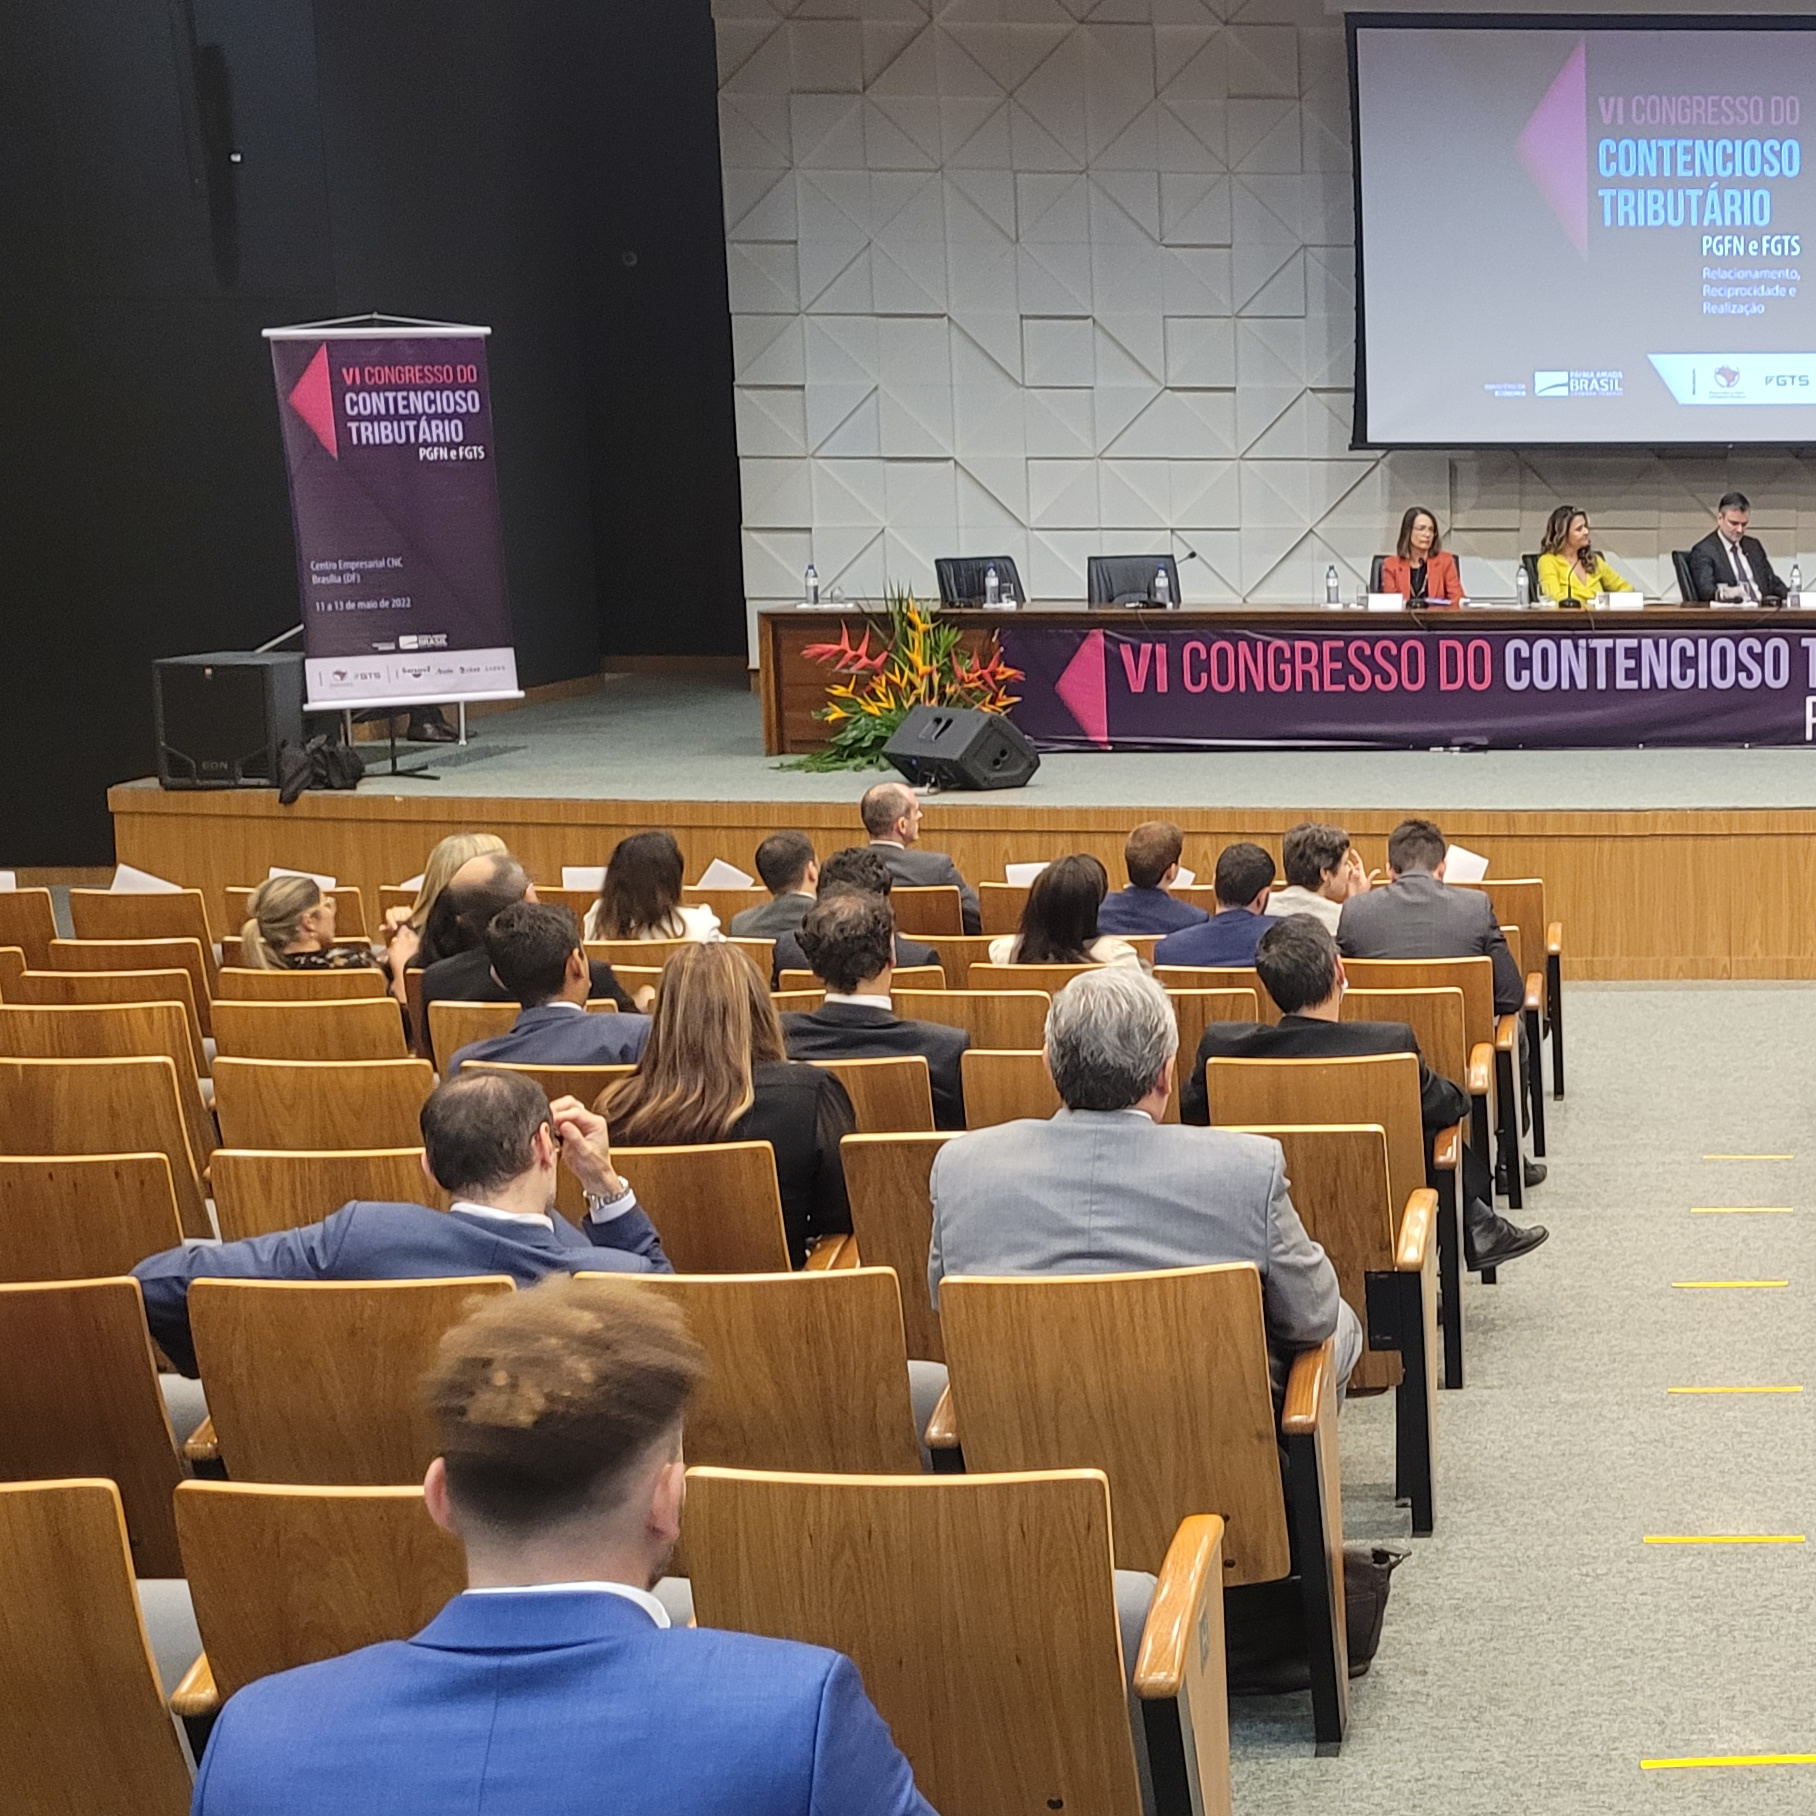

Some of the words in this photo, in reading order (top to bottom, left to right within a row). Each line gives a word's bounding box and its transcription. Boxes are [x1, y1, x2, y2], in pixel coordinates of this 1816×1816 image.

[1599, 96, 1624, 125] VI
[1631, 95, 1763, 125] CONGRESSO
[1771, 95, 1799, 125] DO
[1599, 138, 1800, 178] CONTENCIOSO
[1598, 181, 1771, 227] TRIBUTÁRIO
[1702, 235, 1744, 256] PGFN
[1748, 240, 1759, 256] e
[1762, 235, 1800, 256] FGTS
[1702, 267, 1801, 281] Relacionamento,
[1702, 284, 1787, 299] Reciprocidade
[1788, 286, 1797, 297] e
[1702, 301, 1765, 316] Realização
[342, 367, 360, 385] VI
[364, 364, 453, 385] CONGRESSO
[456, 364, 477, 384] DO
[1570, 379, 1623, 391] BRASIL
[344, 390, 481, 416] CONTENCIOSO
[347, 416, 464, 445] TRIBUTÁRIO
[419, 447, 448, 461] PGFN
[450, 449, 458, 460] e
[459, 446, 486, 460] FGTS
[310, 561, 338, 571] Centro
[338, 559, 386, 571] Empresarial
[315, 601, 325, 612] 11
[334, 600, 344, 612] 13
[345, 600, 356, 611] de
[357, 600, 378, 610] maio
[379, 598, 390, 609] de
[1120, 643, 1168, 693] VI
[1182, 640, 1426, 693] CONGRESSO
[1439, 639, 1492, 692] DO
[1505, 638, 1789, 692] CONTENCIOSO
